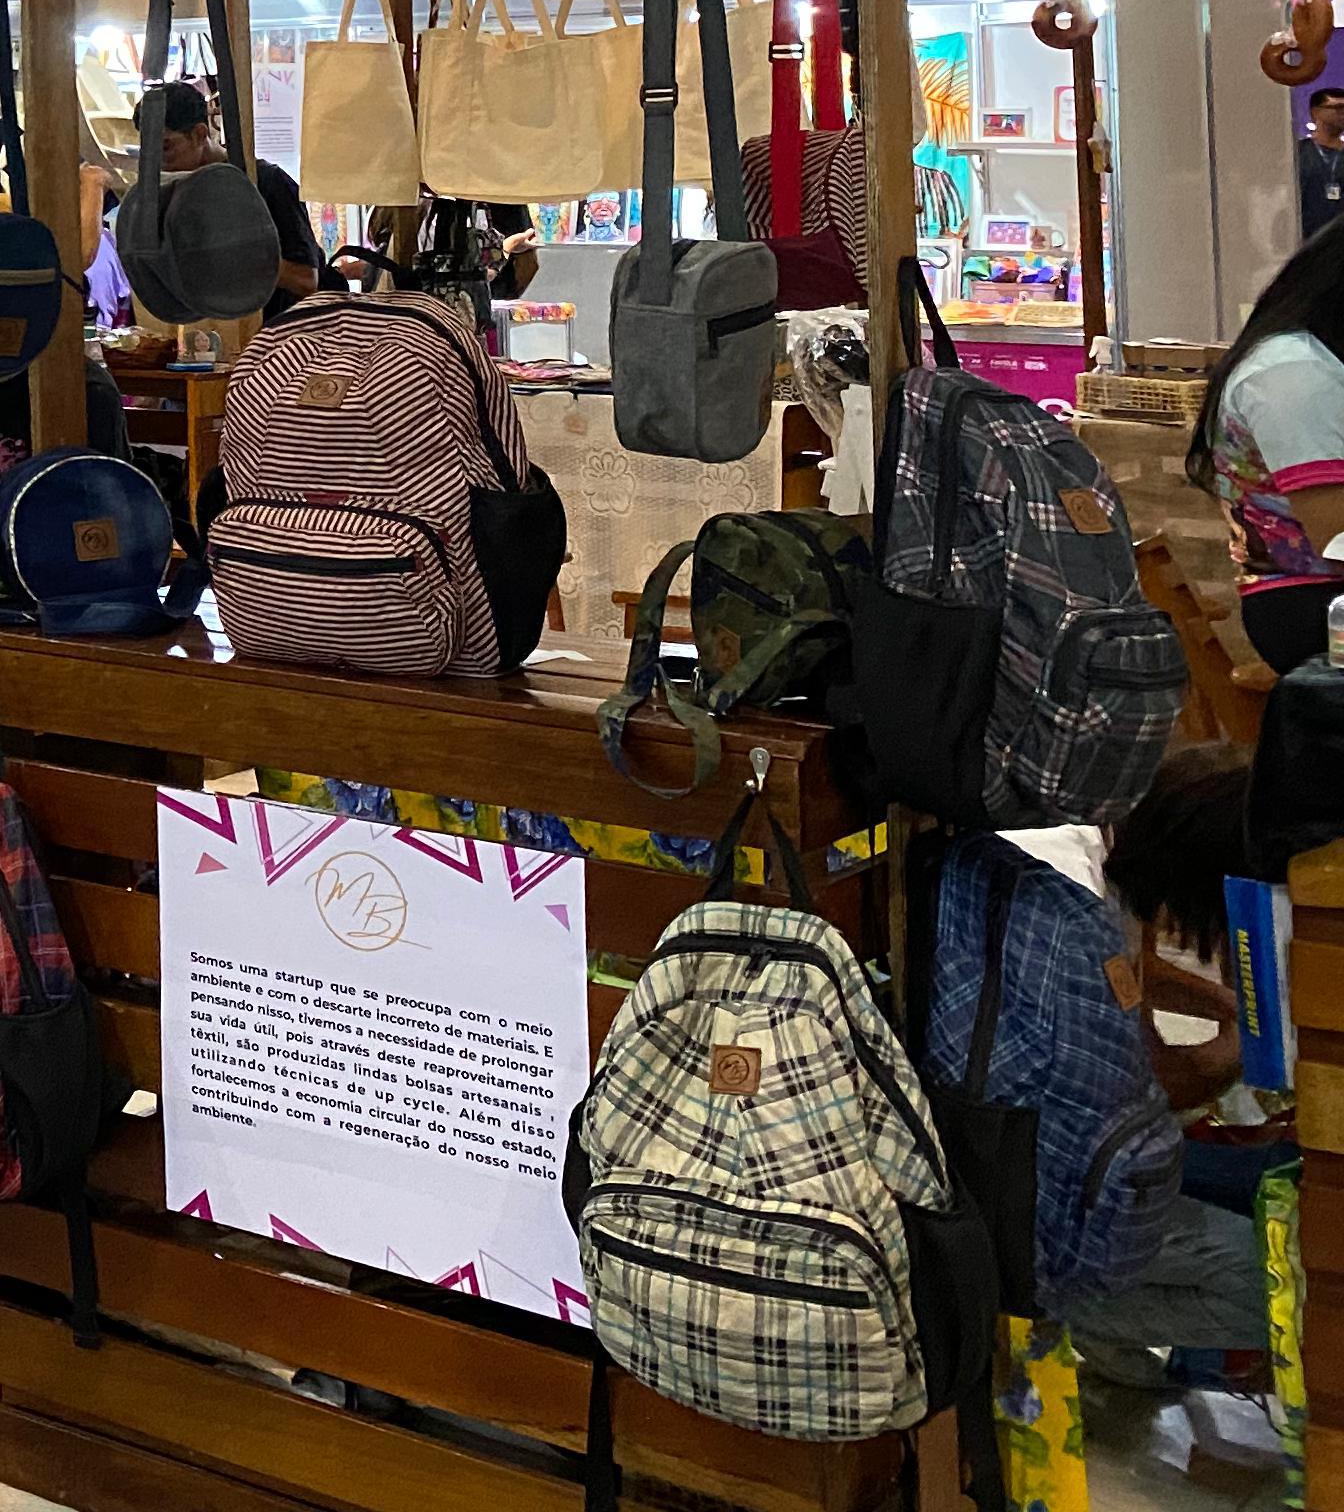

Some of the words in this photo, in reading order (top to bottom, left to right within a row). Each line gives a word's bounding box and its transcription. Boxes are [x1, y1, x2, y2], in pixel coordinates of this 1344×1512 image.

[190, 951, 233, 970] Somos
[239, 963, 268, 977] uma
[274, 970, 323, 991] startup
[329, 982, 356, 996] que
[362, 989, 378, 1000] se
[385, 993, 451, 1016] preocupa
[458, 1009, 490, 1025] com
[498, 1017, 507, 1027] o
[515, 1021, 553, 1037] meio
[190, 971, 251, 993] ambiente
[255, 986, 263, 995] e
[267, 988, 296, 1003] com
[300, 995, 308, 1005] o
[312, 995, 371, 1018] descarte
[376, 1007, 440, 1033] incorreto
[444, 1023, 462, 1038] de
[466, 1030, 539, 1055] materiais.
[543, 1044, 553, 1058] E
[1236, 928, 1261, 1038] MASTERPRINT
[190, 990, 253, 1012] pensando
[257, 1003, 294, 1023] nisso,
[298, 1011, 352, 1033] tivemos
[355, 1026, 363, 1036] a
[367, 1028, 454, 1056] necessidade
[458, 1047, 477, 1061] de
[481, 1053, 553, 1078] prolongar
[190, 1009, 212, 1022] sua
[218, 1013, 246, 1030] vida
[253, 1021, 278, 1039] útil,
[285, 1030, 313, 1045] pois
[320, 1038, 370, 1057] através
[376, 1049, 415, 1068] deste
[423, 1061, 554, 1099] reaproveitamento
[236, 1037, 259, 1052] são
[266, 1045, 345, 1071] produzidas
[353, 1062, 397, 1083] lindas
[405, 1074, 453, 1096] bolsas
[461, 1089, 541, 1116] artesanais
[190, 1046, 265, 1072] utilizando
[273, 1064, 338, 1089] técnicas
[346, 1080, 365, 1095] de
[374, 1088, 394, 1104] up
[402, 1096, 450, 1115] cycle.
[458, 1107, 501, 1128] Além
[510, 1119, 555, 1139] disso
[190, 1063, 275, 1093] fortalecemos
[281, 1087, 289, 1097] a
[295, 1090, 362, 1114] economia
[368, 1105, 421, 1128] circular
[427, 1119, 446, 1133] do
[452, 1127, 494, 1145] nosso
[501, 1139, 556, 1163] estado,
[190, 1085, 278, 1113] contribuindo
[285, 1107, 315, 1122] com
[323, 1116, 331, 1126] a
[339, 1120, 430, 1149] regeneração
[437, 1141, 456, 1156] do
[465, 1150, 509, 1169] nosso
[517, 1162, 557, 1180] meio
[191, 1103, 256, 1127] ambiente.
